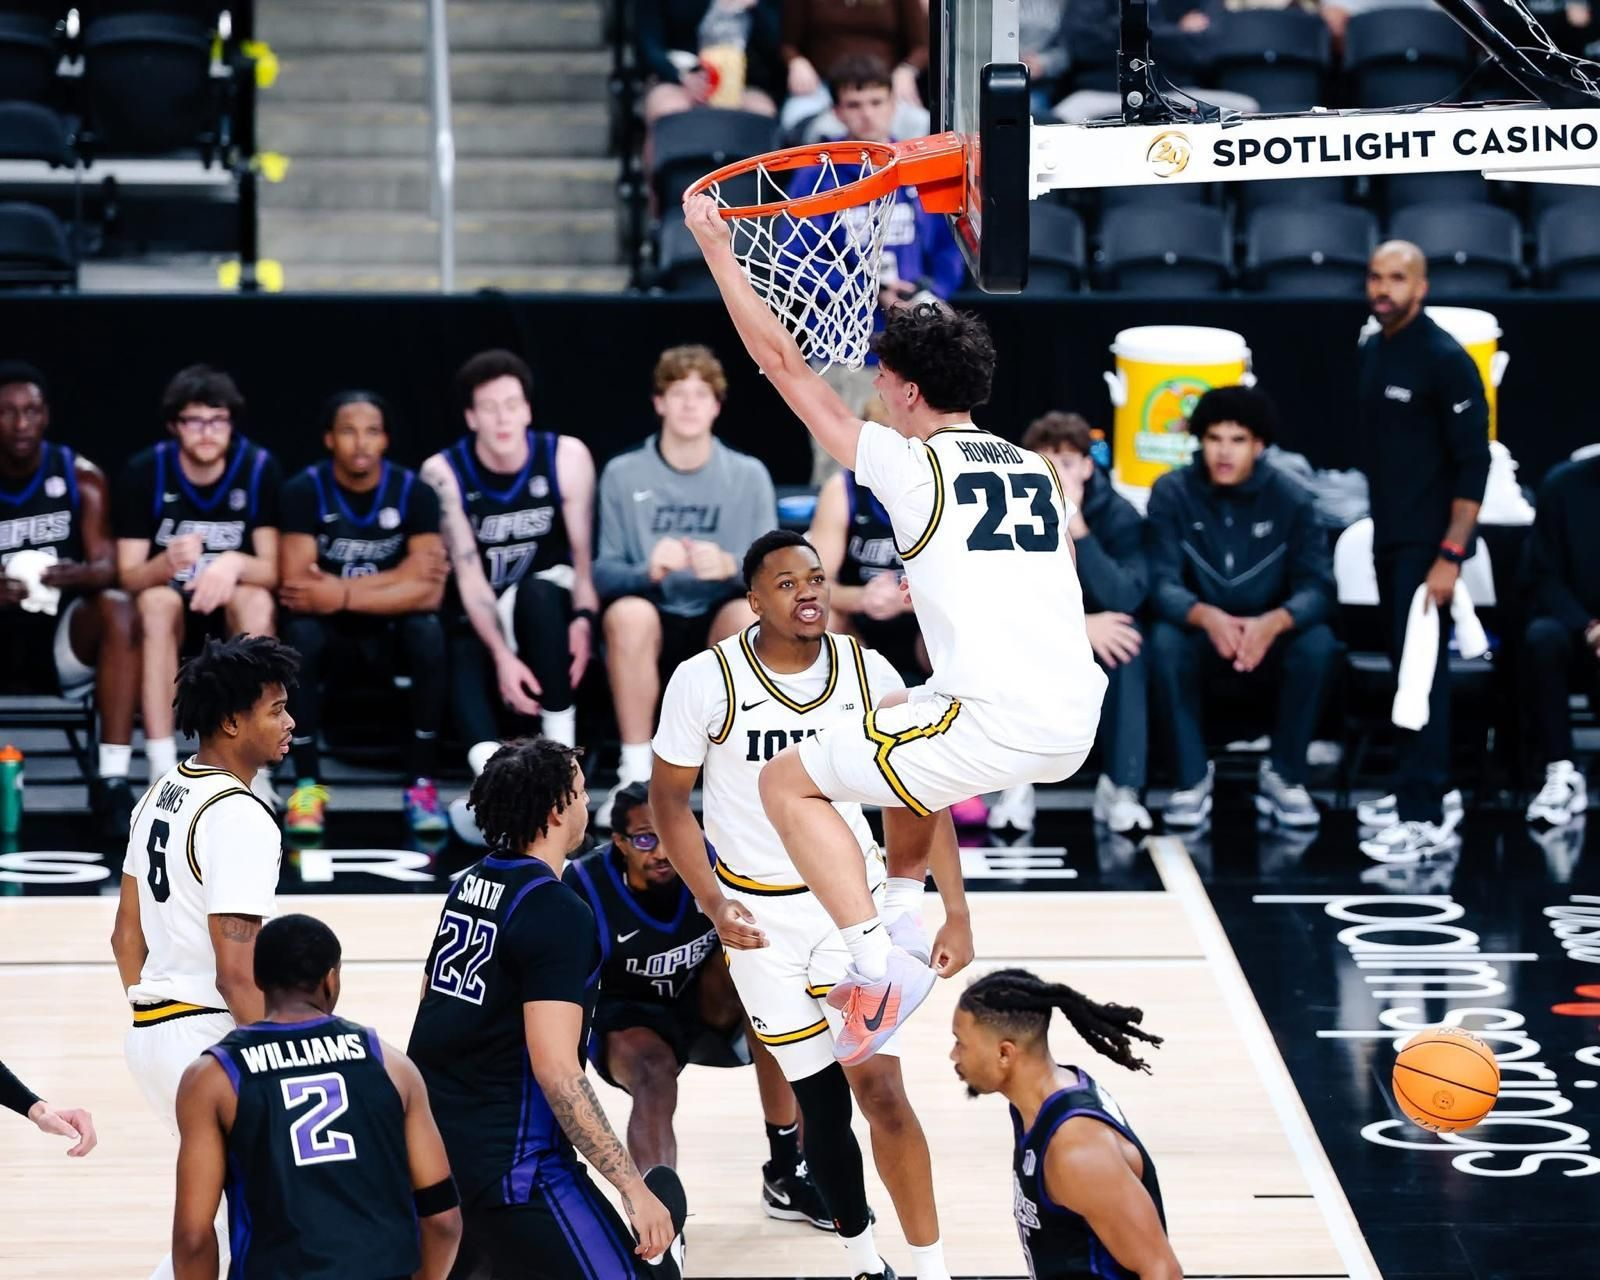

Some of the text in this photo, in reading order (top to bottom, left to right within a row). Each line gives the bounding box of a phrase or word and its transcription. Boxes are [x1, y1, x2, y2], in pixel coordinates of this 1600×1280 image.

[1212, 130, 1437, 167] SPOTLIGHT
[1452, 122, 1598, 156] CASINO
[954, 440, 1024, 464] HOWARD
[953, 470, 1060, 552] 23
[485, 541, 538, 589] 17
[155, 780, 191, 814] BANKS
[146, 818, 171, 903] 6
[457, 873, 506, 911] SMITH
[430, 909, 498, 1006] 22
[1251, 894, 1539, 998] palm
[239, 1033, 367, 1074] WILLIAMS
[280, 1071, 358, 1167] 2
